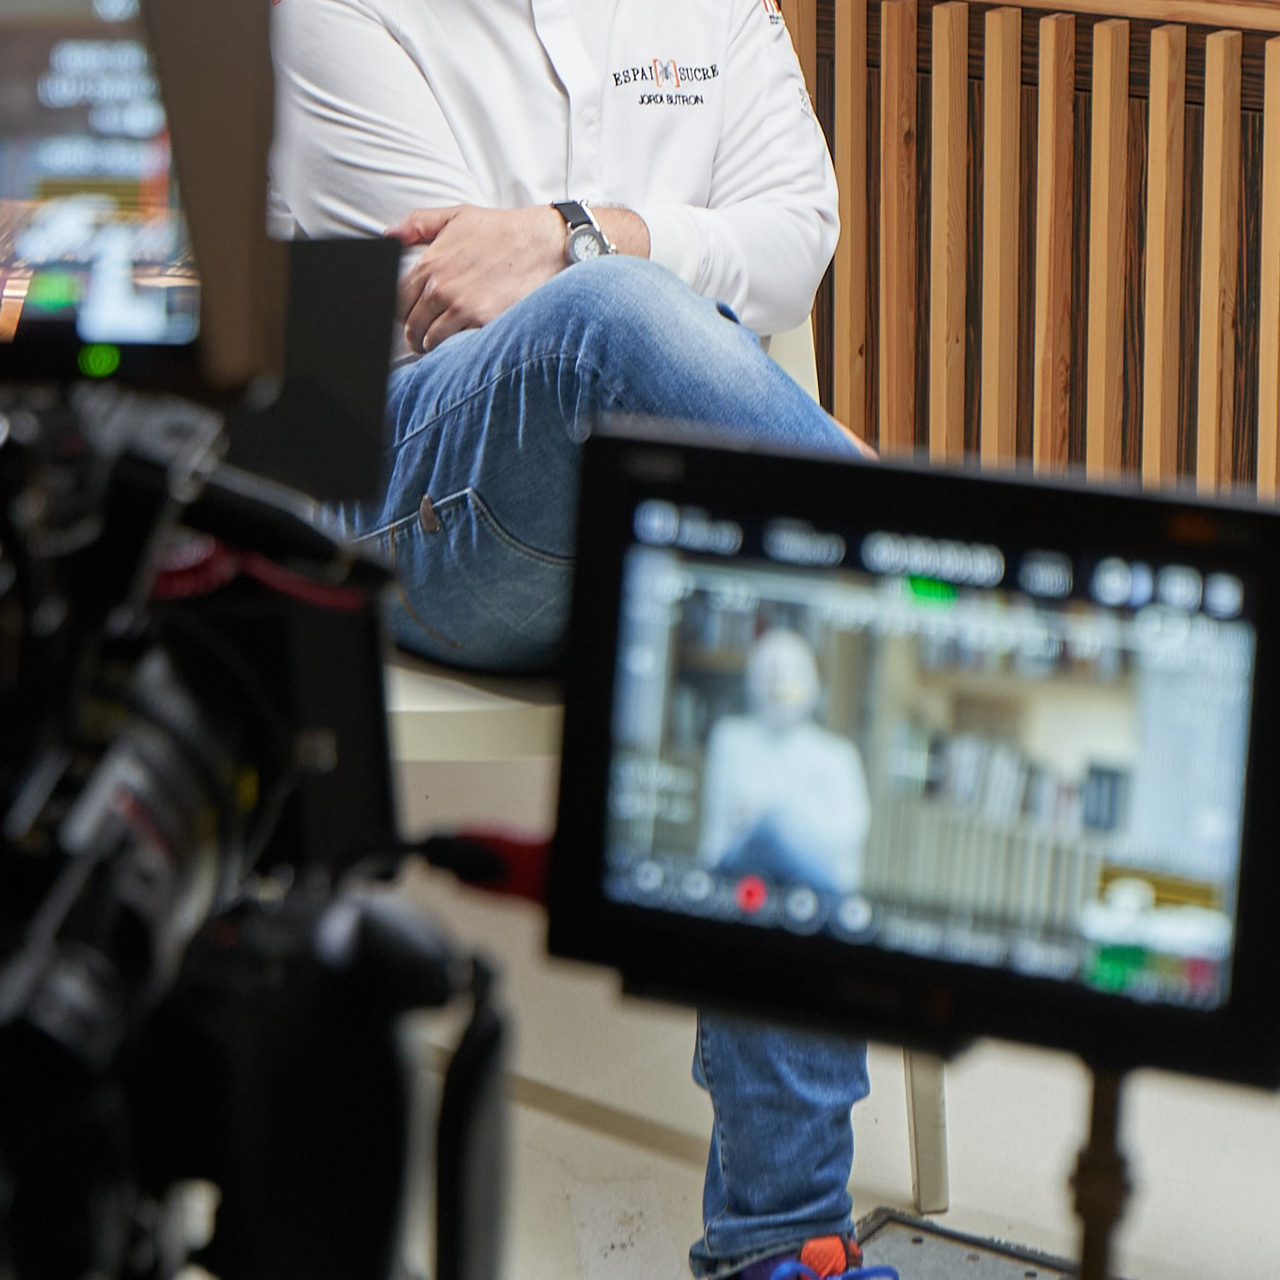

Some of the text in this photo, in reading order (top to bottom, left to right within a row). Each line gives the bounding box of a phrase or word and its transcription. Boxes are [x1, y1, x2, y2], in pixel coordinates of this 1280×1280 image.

[612, 63, 719, 87] ESPAI SUCRE
[638, 94, 704, 105] JORDI BUTRON
